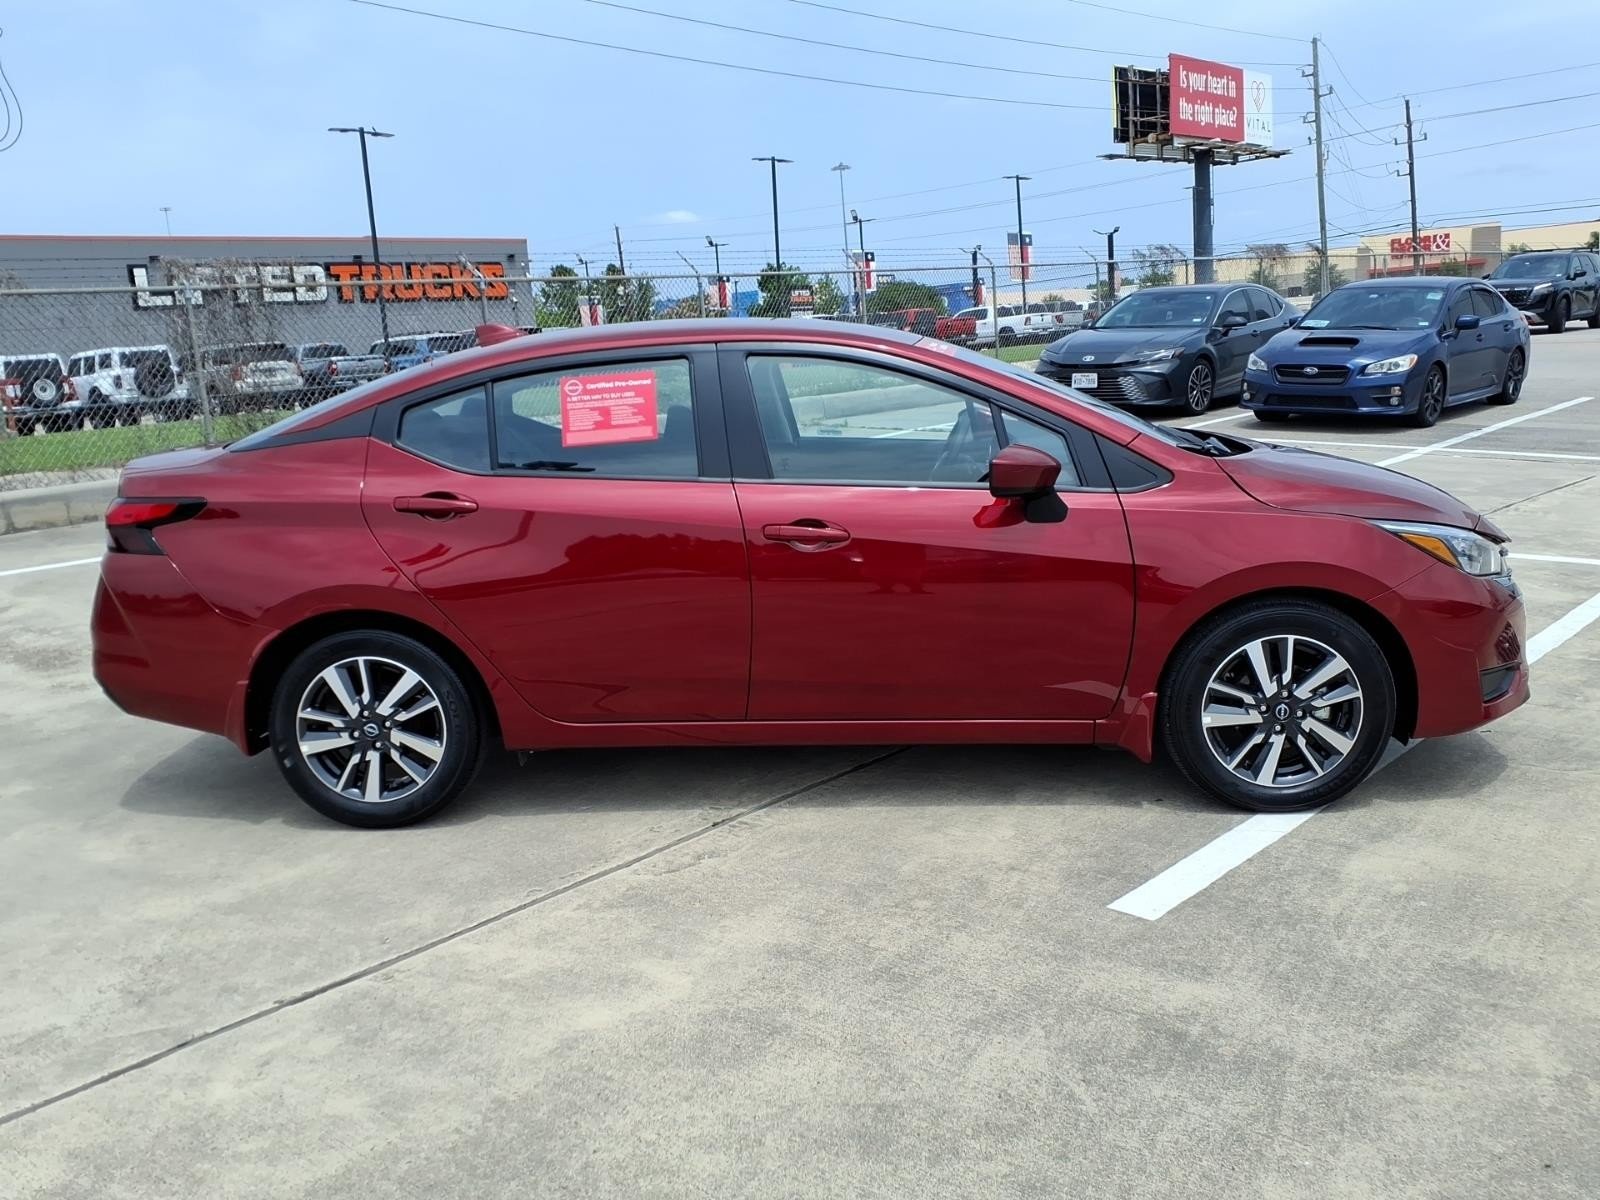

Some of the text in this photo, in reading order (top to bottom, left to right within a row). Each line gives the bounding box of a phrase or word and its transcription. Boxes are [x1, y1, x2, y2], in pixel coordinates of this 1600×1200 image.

[1179, 64, 1236, 98] Is your heart in
[1179, 97, 1238, 128] the right place?
[1246, 115, 1271, 132] VITAL
[1433, 233, 1451, 252] &
[328, 264, 507, 301] TRUCKS
[586, 381, 614, 390] Certified
[614, 378, 652, 387] Pre-Owned
